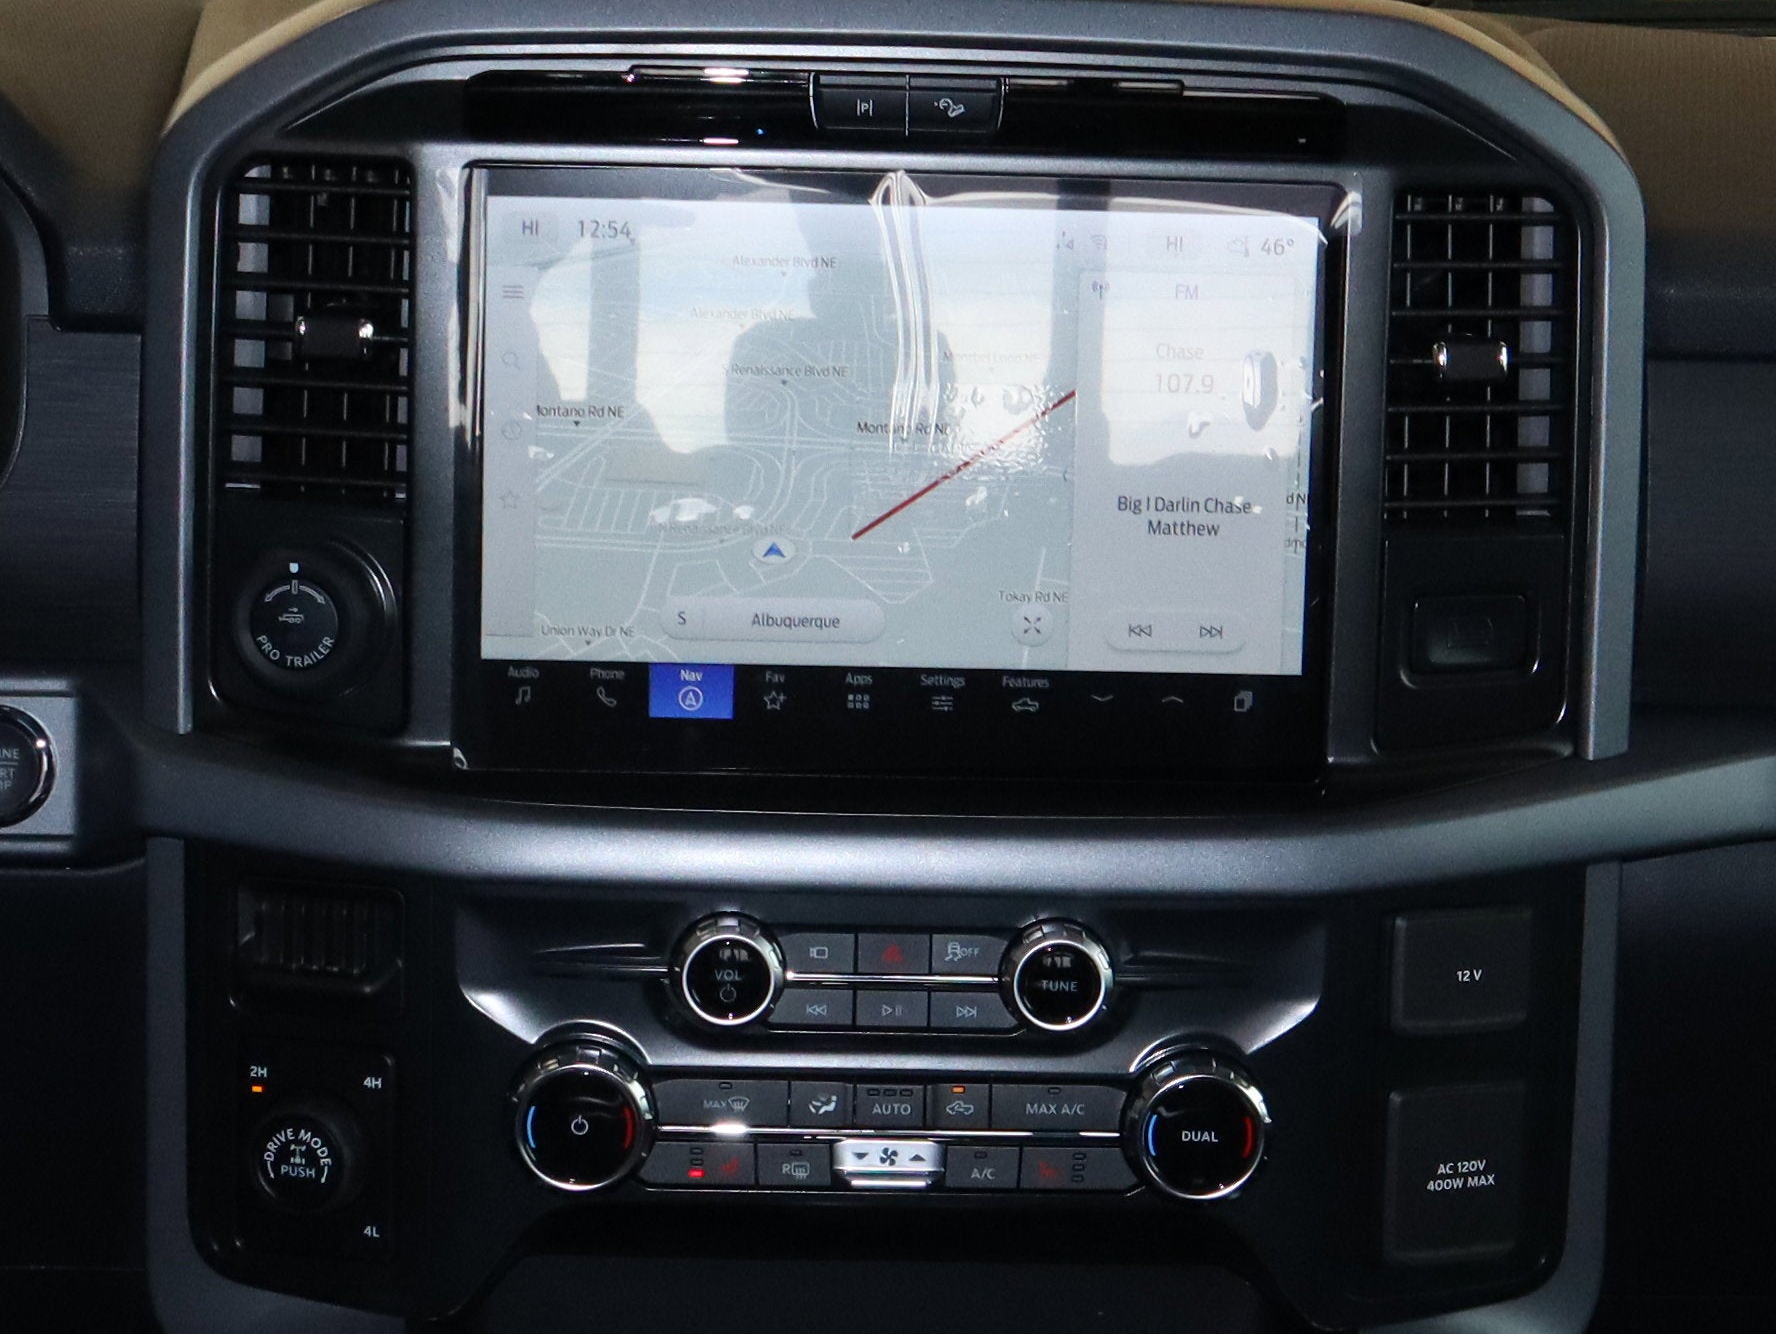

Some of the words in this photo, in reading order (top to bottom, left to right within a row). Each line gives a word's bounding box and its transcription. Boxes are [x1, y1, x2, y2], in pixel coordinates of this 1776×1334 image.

[521, 220, 540, 236] HI
[577, 219, 631, 239] 12:54
[1166, 236, 1184, 253] HI
[1260, 238, 1295, 256] 46°
[732, 254, 790, 267] Alexander
[792, 255, 819, 268] Blvd
[821, 257, 837, 268] NE
[1175, 284, 1199, 301] FM
[1156, 343, 1204, 361] Chase
[732, 363, 800, 377] Renaissance
[803, 364, 831, 378] Blvd
[832, 366, 849, 378] NE
[1154, 373, 1215, 394] 107.9
[587, 404, 604, 419] Rd
[607, 405, 624, 419] NE
[1117, 496, 1141, 515] Big
[1154, 496, 1201, 513] Darlin
[1204, 497, 1252, 515] Chase
[1147, 520, 1220, 536] Matthew
[998, 590, 1031, 604] Tokay
[1035, 591, 1051, 603] Rd
[1052, 592, 1069, 603] NE
[677, 611, 686, 626] S
[751, 612, 841, 630] Albuquerque
[540, 625, 574, 637] Union
[577, 625, 601, 640] Way
[604, 625, 617, 637] Dr
[619, 626, 635, 637] NE
[256, 634, 281, 662] PRO
[285, 635, 336, 668] TRAILER
[507, 666, 540, 679] Audio
[590, 666, 625, 680] Phone
[680, 670, 704, 683] Nav
[765, 671, 786, 684] Fav
[846, 672, 873, 687] Apps
[920, 673, 966, 690] Settings
[1002, 675, 1051, 690] Features
[961, 946, 980, 957] OFF
[714, 969, 742, 982] VOL
[1456, 969, 1472, 983] 12
[1473, 969, 1484, 982] V
[1040, 979, 1079, 993] TUNE
[249, 1064, 268, 1079] 2H
[363, 1075, 383, 1091] 4H
[871, 1102, 912, 1116] AUTO
[1025, 1102, 1058, 1115] MAX
[1060, 1102, 1085, 1116] A/C
[1181, 1129, 1219, 1143] DUAL
[264, 1127, 295, 1163] DRIVE
[298, 1127, 333, 1167] MODE
[280, 1164, 316, 1179] PUSH
[970, 1167, 996, 1181] A/C
[1437, 1162, 1455, 1175] AC
[1456, 1159, 1488, 1173] 120V
[1426, 1177, 1464, 1192] 400W
[1467, 1174, 1497, 1188] MAX
[363, 1224, 381, 1239] 4L
